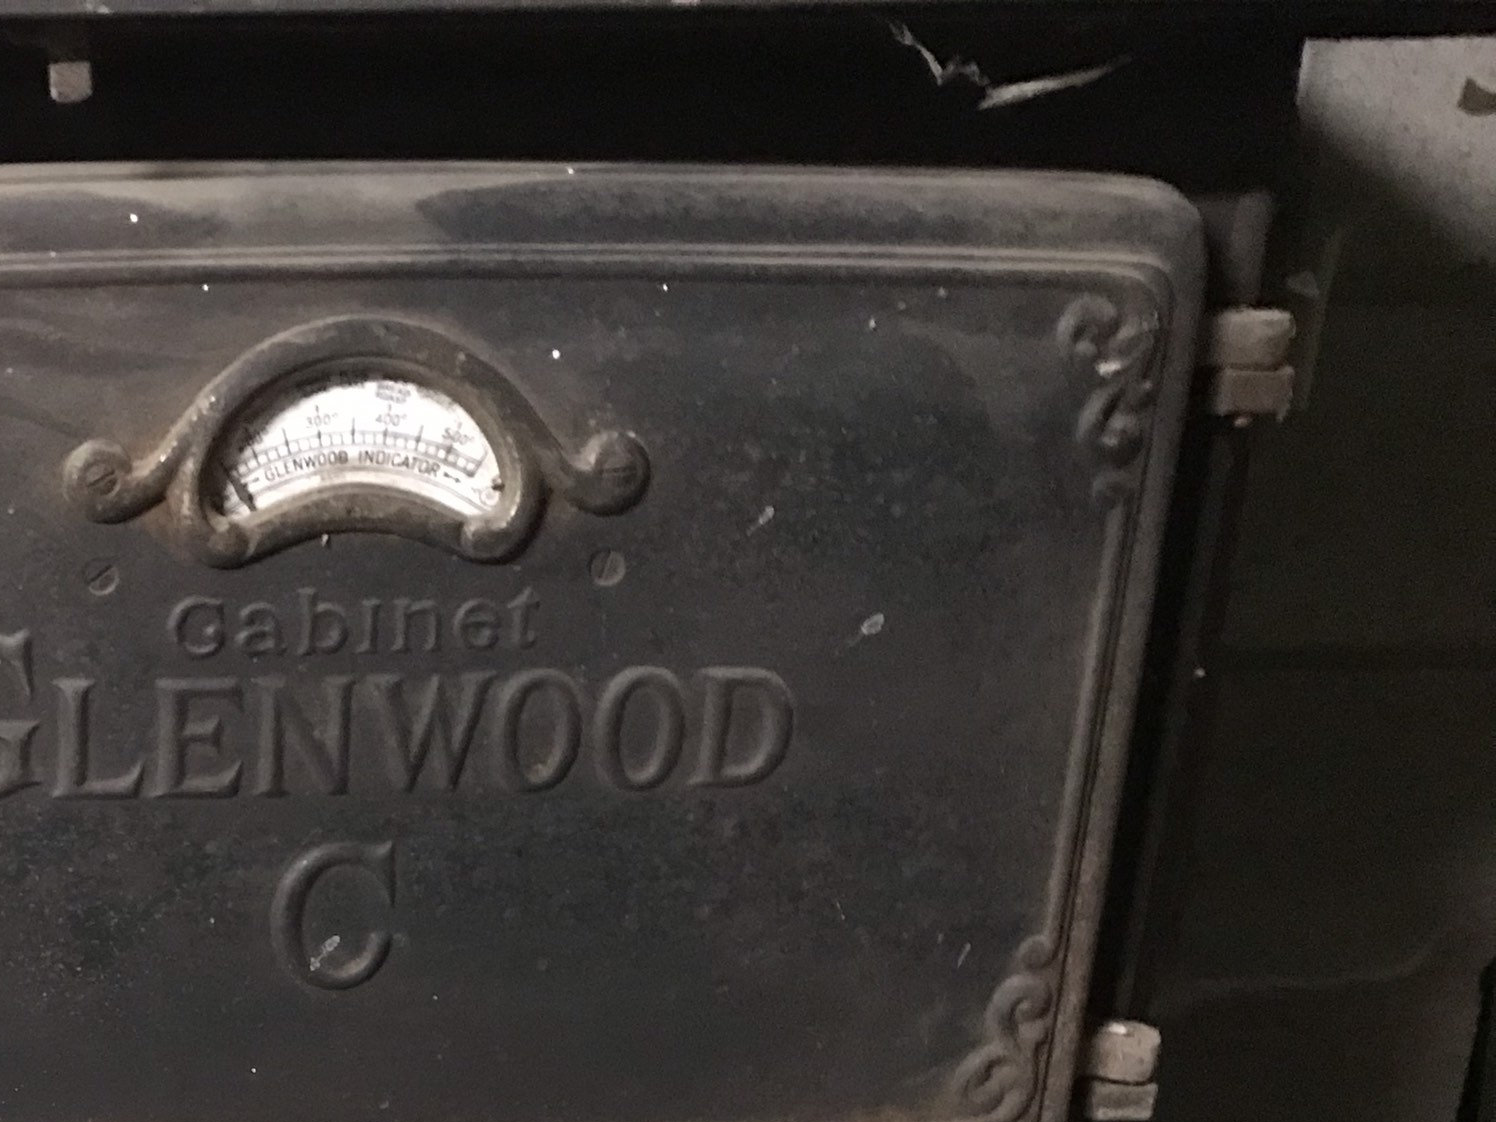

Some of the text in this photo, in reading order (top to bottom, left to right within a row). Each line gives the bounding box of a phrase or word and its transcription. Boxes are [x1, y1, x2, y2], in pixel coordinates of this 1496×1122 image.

[264, 449, 441, 482] GLENWOOD INDICATOR
[166, 585, 544, 660] Cabinet
[268, 839, 398, 990] C
